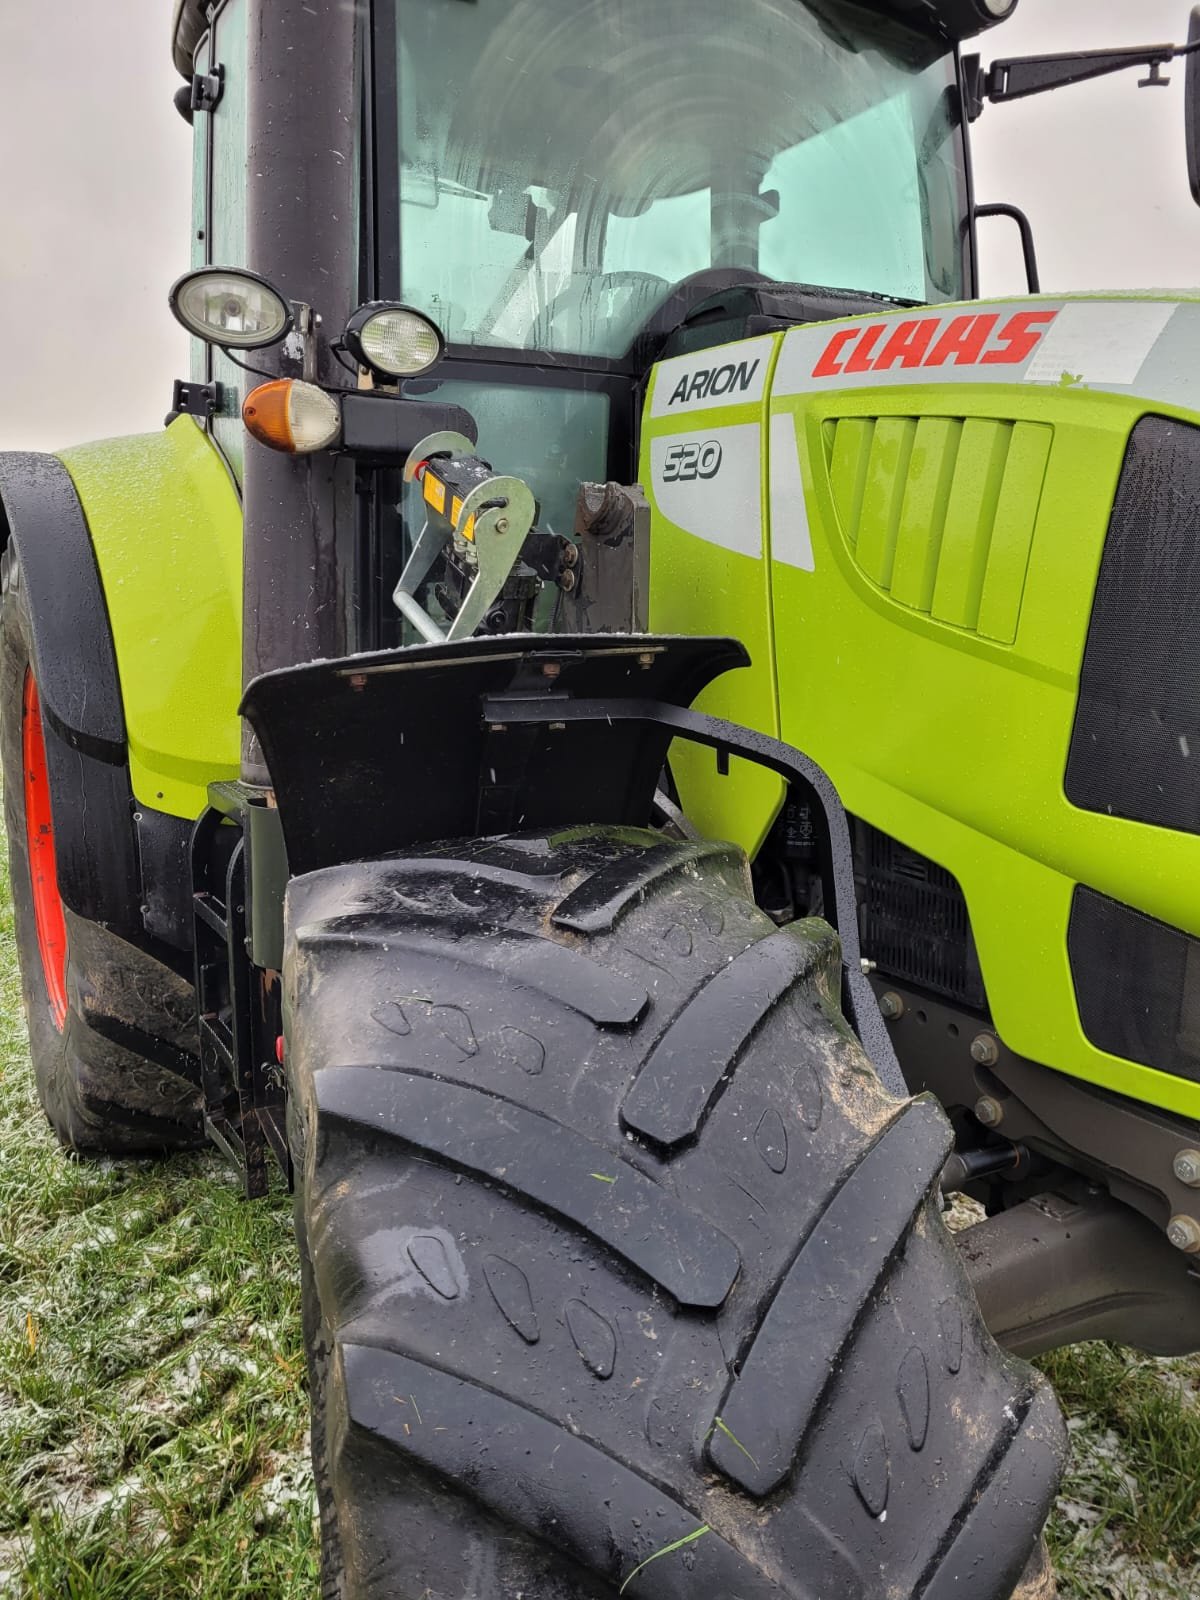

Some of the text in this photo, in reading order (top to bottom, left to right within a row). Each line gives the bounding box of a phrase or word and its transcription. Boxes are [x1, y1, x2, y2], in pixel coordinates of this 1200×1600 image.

[812, 311, 1057, 378] CLAAS
[668, 358, 760, 406] ARION
[662, 440, 723, 483] 520
